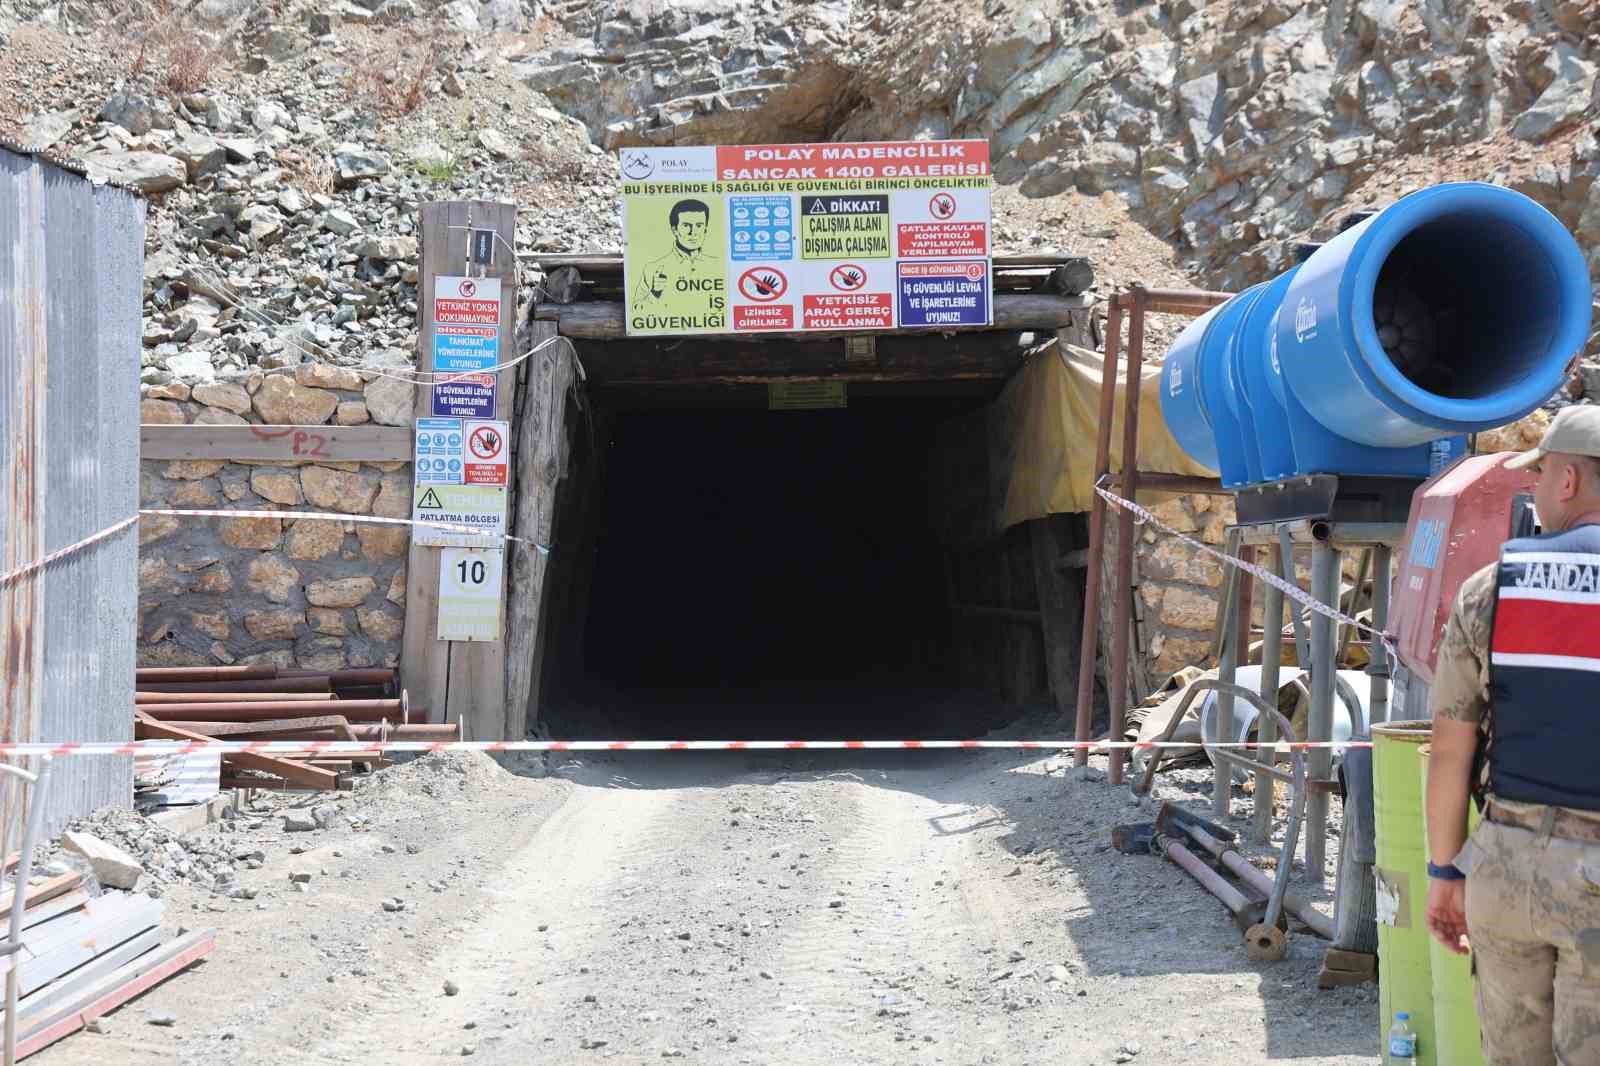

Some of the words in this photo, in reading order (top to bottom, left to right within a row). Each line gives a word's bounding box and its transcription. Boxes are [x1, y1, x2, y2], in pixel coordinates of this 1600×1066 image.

[744, 148, 814, 161] POLAY
[822, 144, 965, 160] MADENCİLİK
[661, 159, 689, 168] POLAY
[722, 167, 816, 180] SANCAK
[825, 166, 874, 178] 1400
[882, 161, 987, 177] GALERİSİ
[624, 186, 640, 194] BU
[644, 182, 708, 195] İŞYERİNDE
[712, 182, 723, 195] İŞ
[727, 181, 775, 193] SAĞLIĞI
[779, 182, 793, 192] VE
[797, 178, 862, 192] GÜVENLİĞİ
[865, 177, 911, 190] BİRİNCİ
[914, 177, 988, 189] ÖNCELİKTİR!
[830, 198, 881, 213] DİKKAT!
[809, 217, 852, 236] ÇALIŞMA
[853, 218, 882, 232] ALANI
[900, 225, 940, 234] ÇATLAK
[943, 224, 984, 232] KAVLAK
[914, 231, 970, 240] KONTROLÜ
[805, 237, 844, 255] DIŞINDA
[845, 236, 888, 253] ÇALIŞMA
[911, 240, 975, 248] YAPILMAYAN
[902, 248, 945, 256] YERLERE
[946, 246, 984, 255] GİRME
[675, 275, 724, 292] ÖNCE
[904, 282, 911, 296] İŞ
[912, 280, 955, 294] GÜVENLİĞİ
[956, 282, 982, 293] LEVHA
[709, 293, 725, 312] İŞ
[816, 294, 879, 305] YETKİSİZ
[909, 299, 921, 309] VE
[921, 296, 977, 311] İŞARETLERİNE
[471, 302, 498, 313] YOKSA
[744, 306, 783, 317] İZİNSİZ
[805, 308, 841, 318] ARAÇ
[845, 306, 890, 317] GEREÇ
[632, 312, 726, 330] GÜVENLİĞİ
[738, 317, 789, 328] GİRİLMEZ
[811, 317, 885, 328] KULLANMA
[925, 311, 961, 323] UYUNUZ!
[473, 387, 492, 397] LEVHA
[440, 396, 448, 405] VE
[420, 513, 463, 522] PATLATMA
[464, 513, 500, 524] BÖLGESİ
[457, 559, 485, 585] 10
